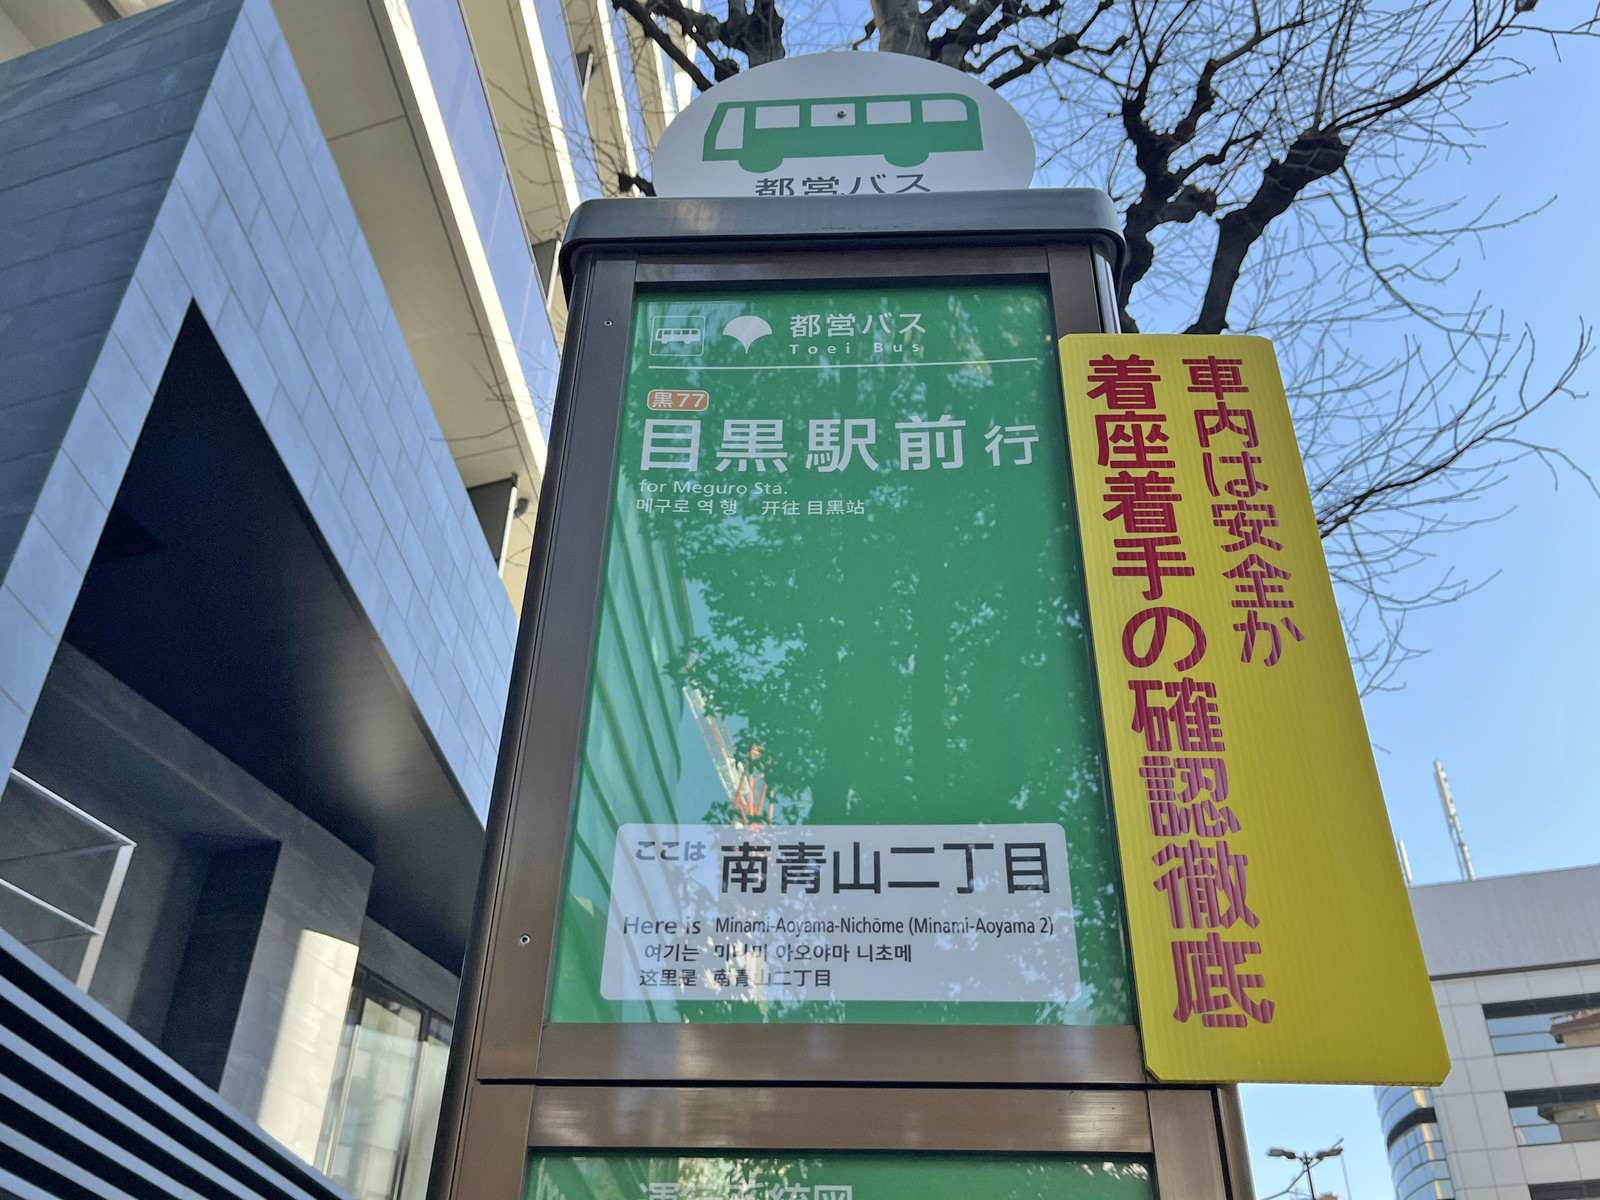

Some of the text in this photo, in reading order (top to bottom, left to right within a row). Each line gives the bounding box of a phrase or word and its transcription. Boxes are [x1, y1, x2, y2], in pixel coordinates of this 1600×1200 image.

[755, 174, 931, 196] 都営バス
[789, 312, 927, 338] 都営バス
[789, 342, 920, 355] Toei Bus
[651, 392, 706, 409] 黒77
[638, 479, 788, 497] for Meguro Sta.
[636, 498, 738, 516] 메구로 역 행
[1182, 355, 1306, 667] 車内は安全か
[1086, 354, 1276, 1028] 着座着手の確認徹底
[635, 841, 1051, 894] ここは 南青山二丁目
[623, 916, 1055, 937] Here is Minami-Aoyama-Nichōme (Minami-Aoyama 2)
[644, 943, 912, 963] 여기는 미나미 아오야마 니초메
[639, 968, 832, 987] 这里是 南青山二丁目
